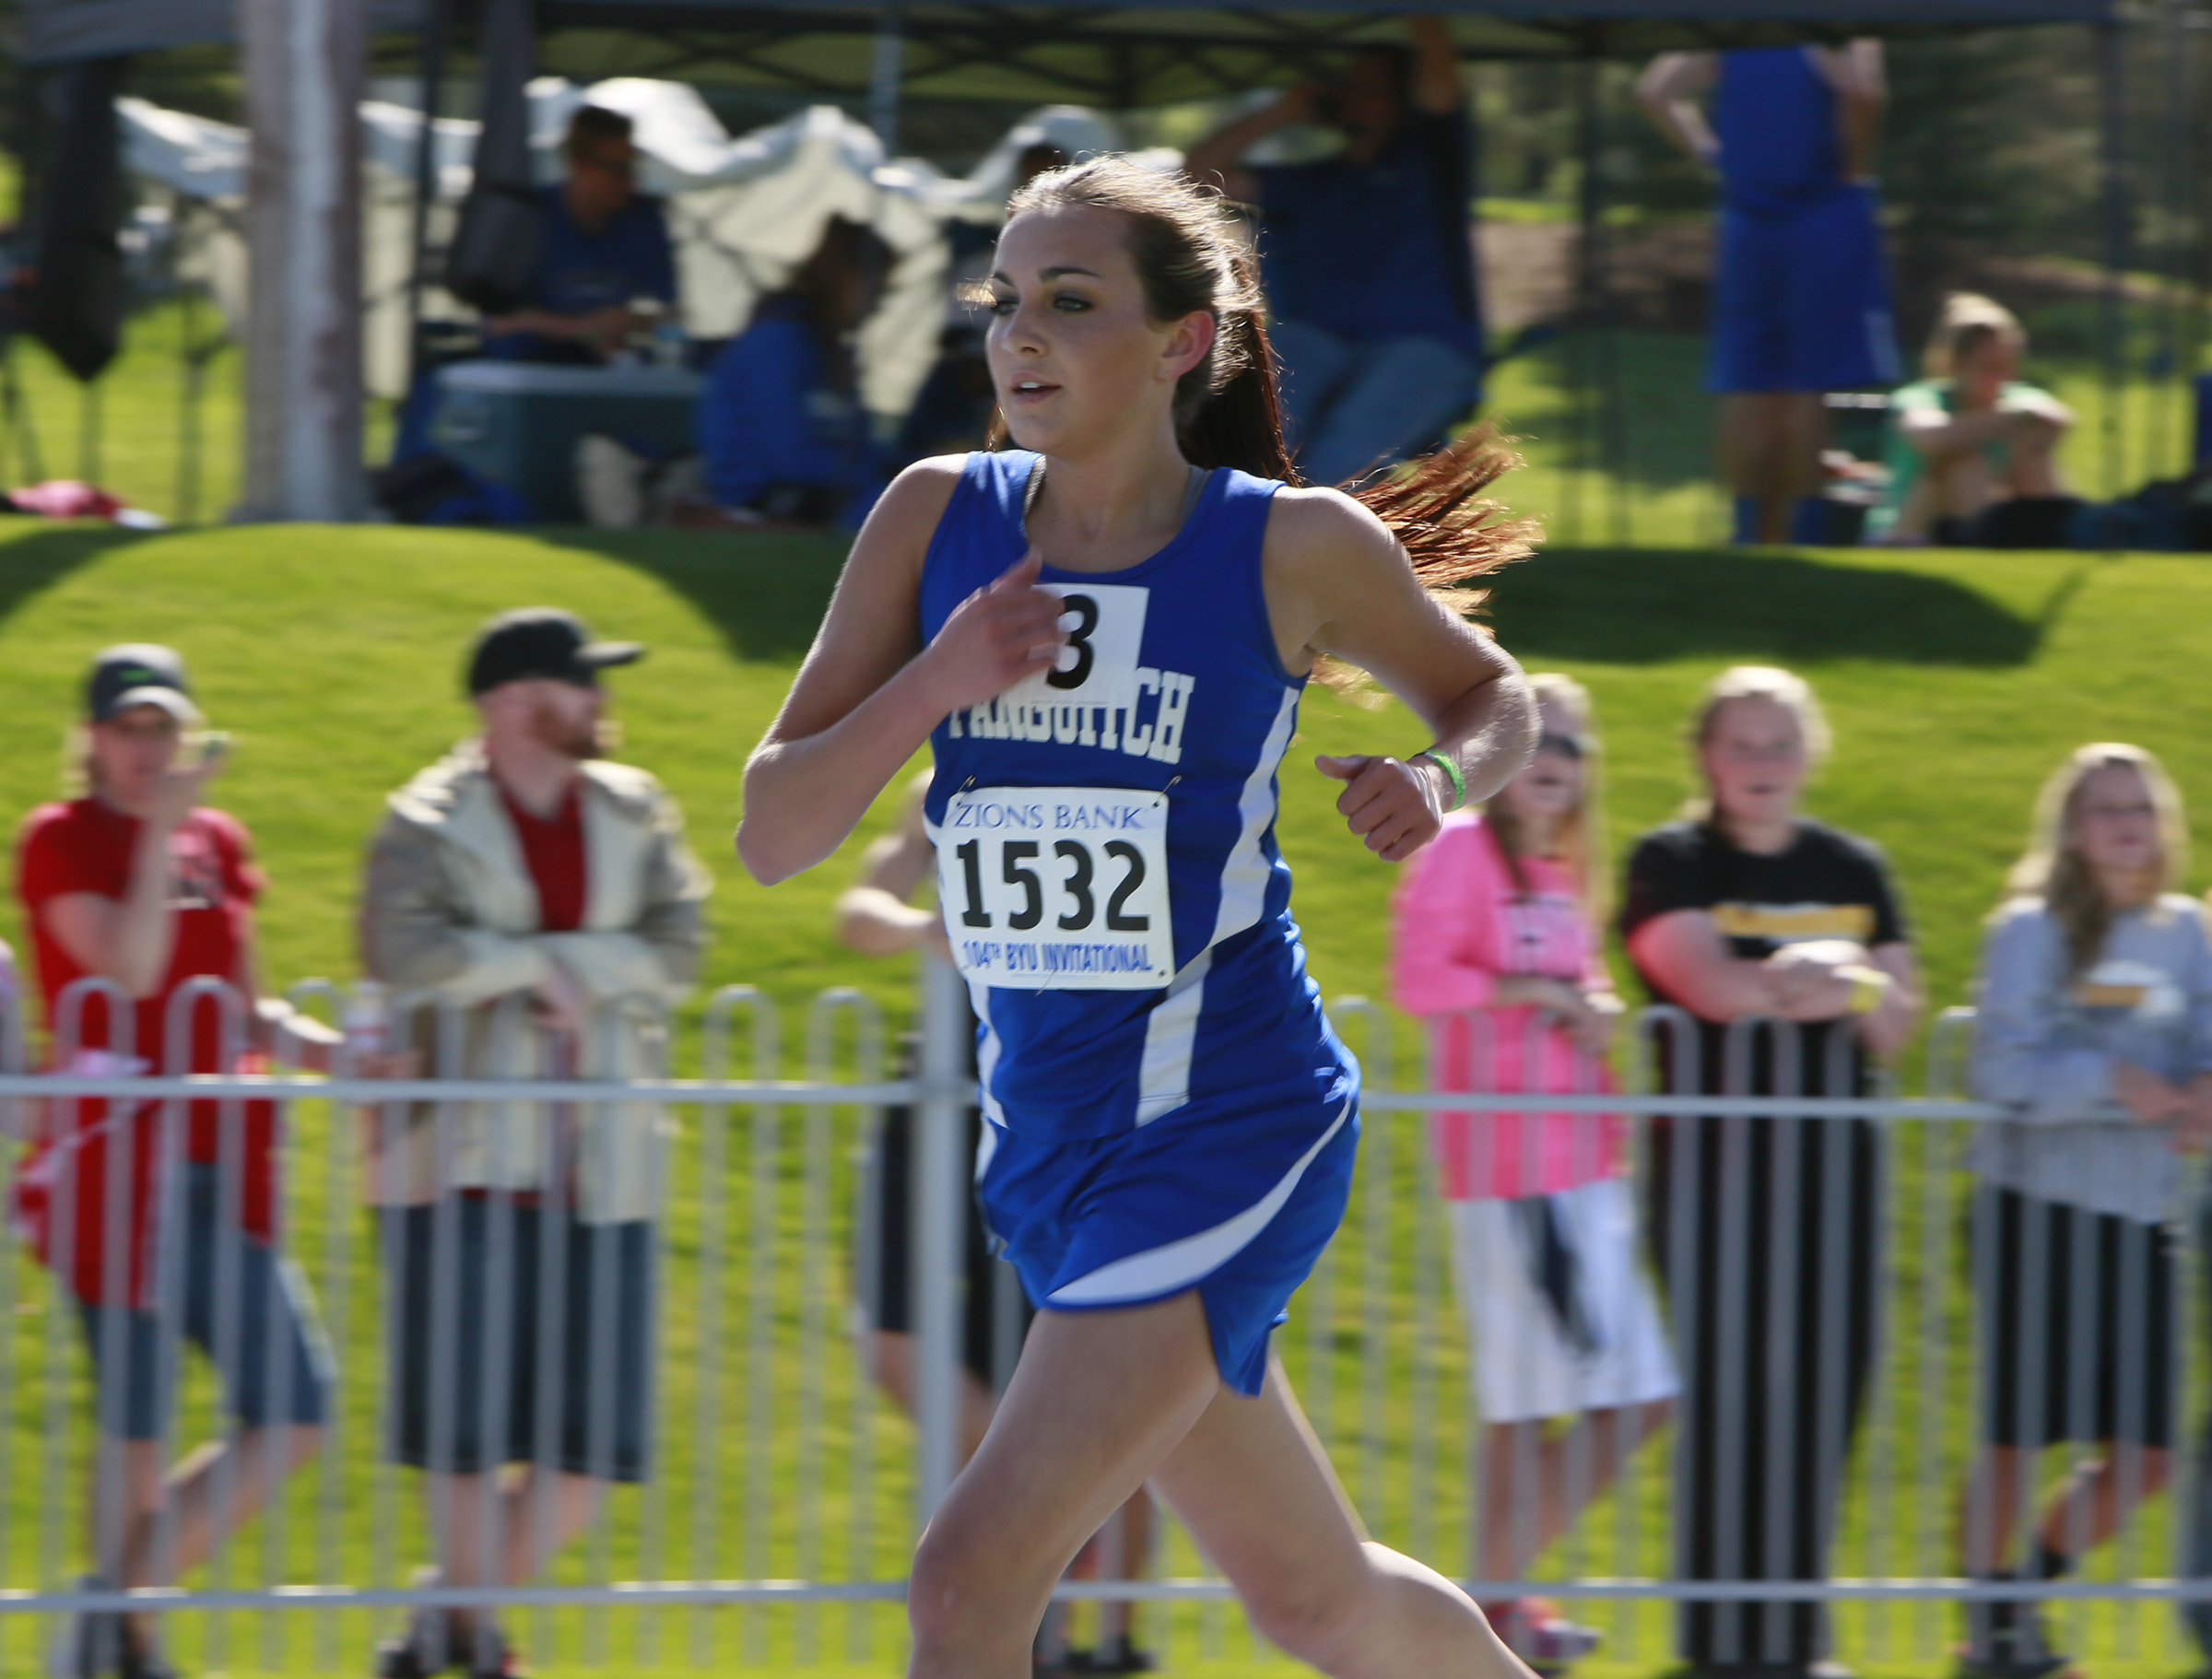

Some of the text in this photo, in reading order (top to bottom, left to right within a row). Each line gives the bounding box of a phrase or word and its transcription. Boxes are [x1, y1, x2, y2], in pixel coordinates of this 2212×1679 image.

[1047, 593, 1100, 689] 3
[949, 666, 1195, 764] ANGUICH
[954, 803, 1146, 829] ZIONS BANK
[957, 839, 1151, 931] 1532
[1006, 941, 1038, 970] BYU
[1041, 942, 1154, 972] INVITATIONAL
